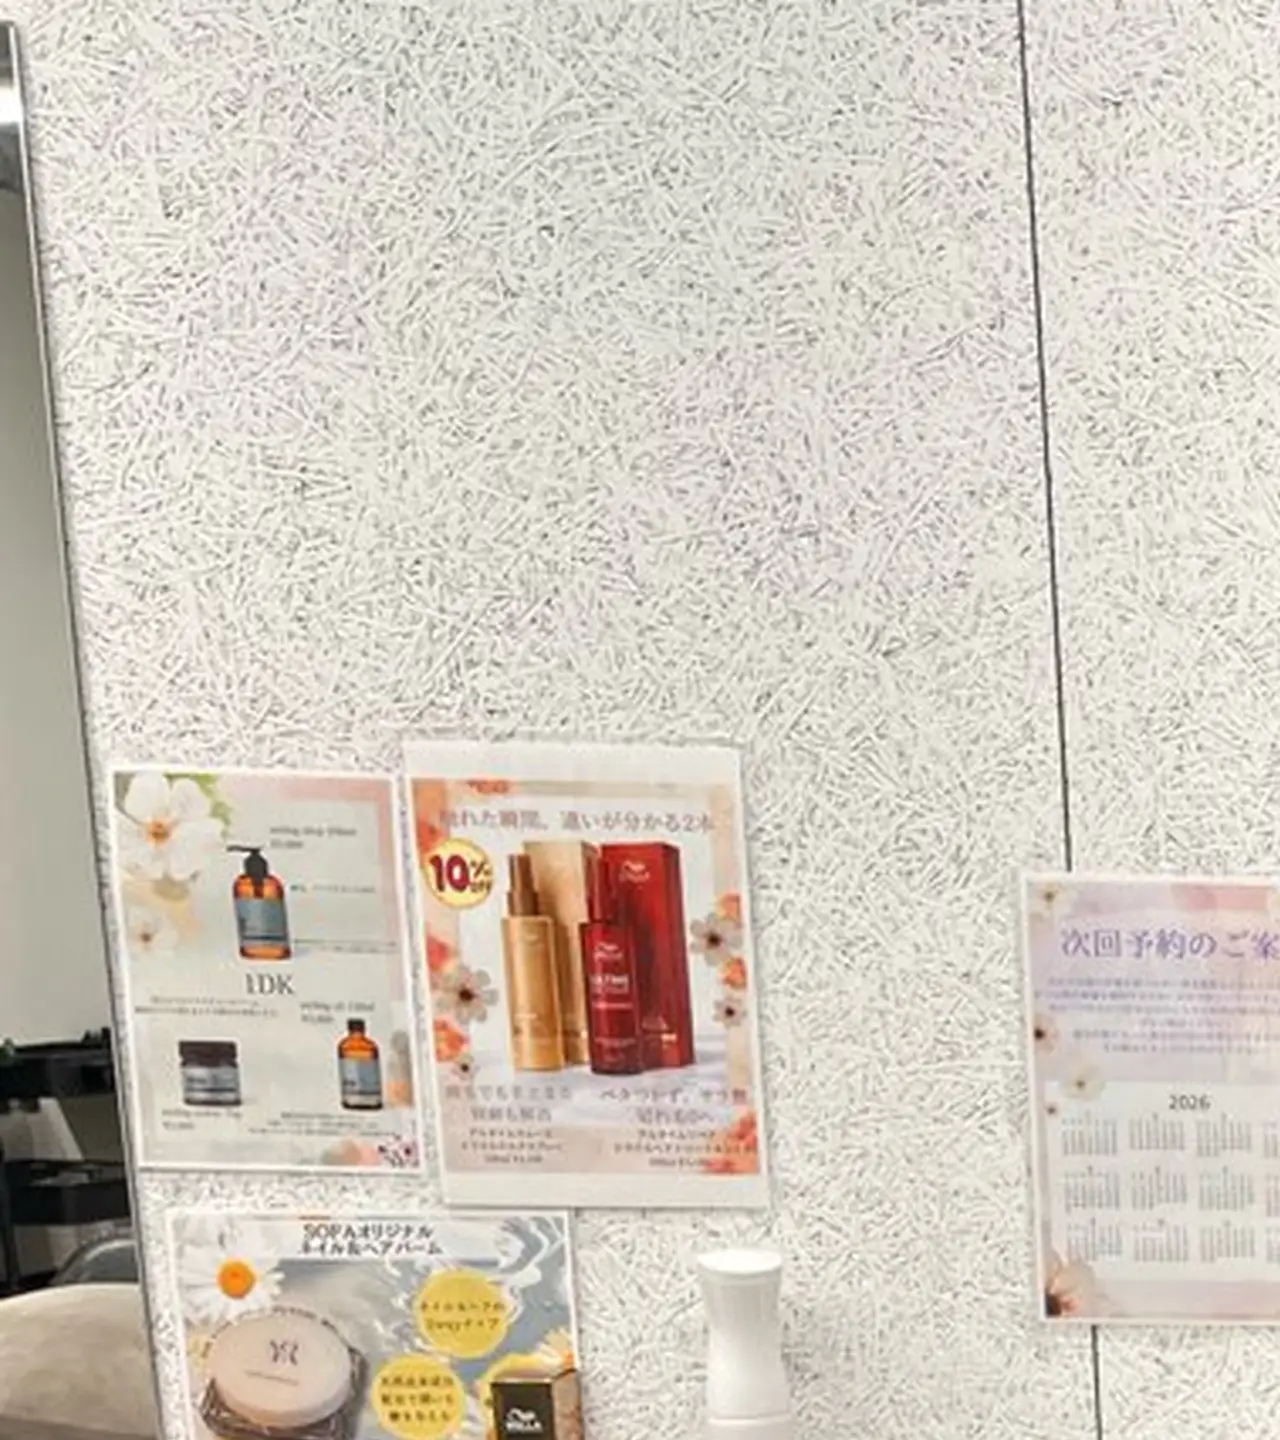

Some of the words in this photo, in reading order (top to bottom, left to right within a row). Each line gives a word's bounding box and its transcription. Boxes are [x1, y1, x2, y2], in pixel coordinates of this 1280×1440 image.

[1167, 1093, 1213, 1111] 2026
[302, 1222, 436, 1240] SOFAオリジナル
